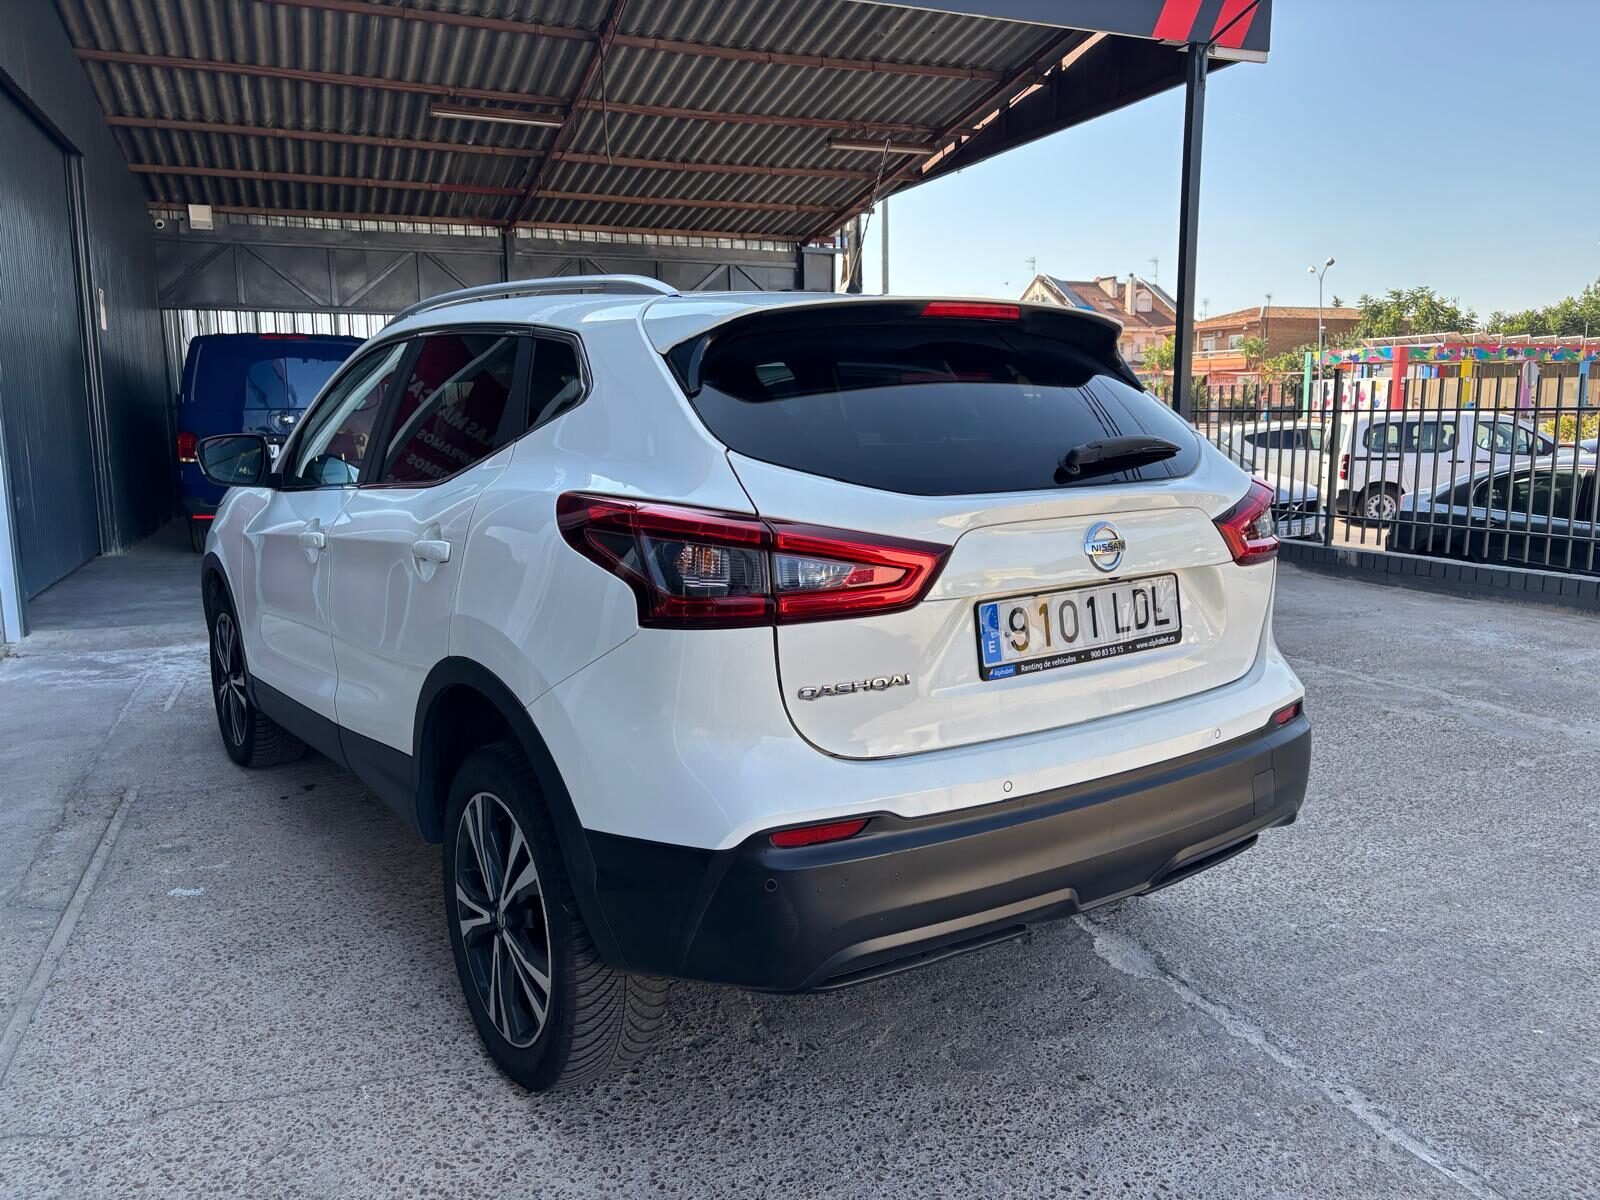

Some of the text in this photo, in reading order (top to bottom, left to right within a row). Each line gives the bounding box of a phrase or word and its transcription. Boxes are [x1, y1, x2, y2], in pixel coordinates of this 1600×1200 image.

[1091, 542, 1125, 553] NISSAN
[1008, 585, 1170, 652] 9101 LDL
[993, 666, 1014, 677] Alphabet
[1020, 662, 1043, 673] Renting
[1043, 660, 1051, 669] de
[1090, 649, 1101, 659] 900
[1101, 648, 1109, 657] 83
[1109, 646, 1117, 655] 55
[1117, 645, 1124, 653] 15
[1135, 635, 1176, 649] www.alphabet.es
[797, 673, 911, 701] QASHQAI
